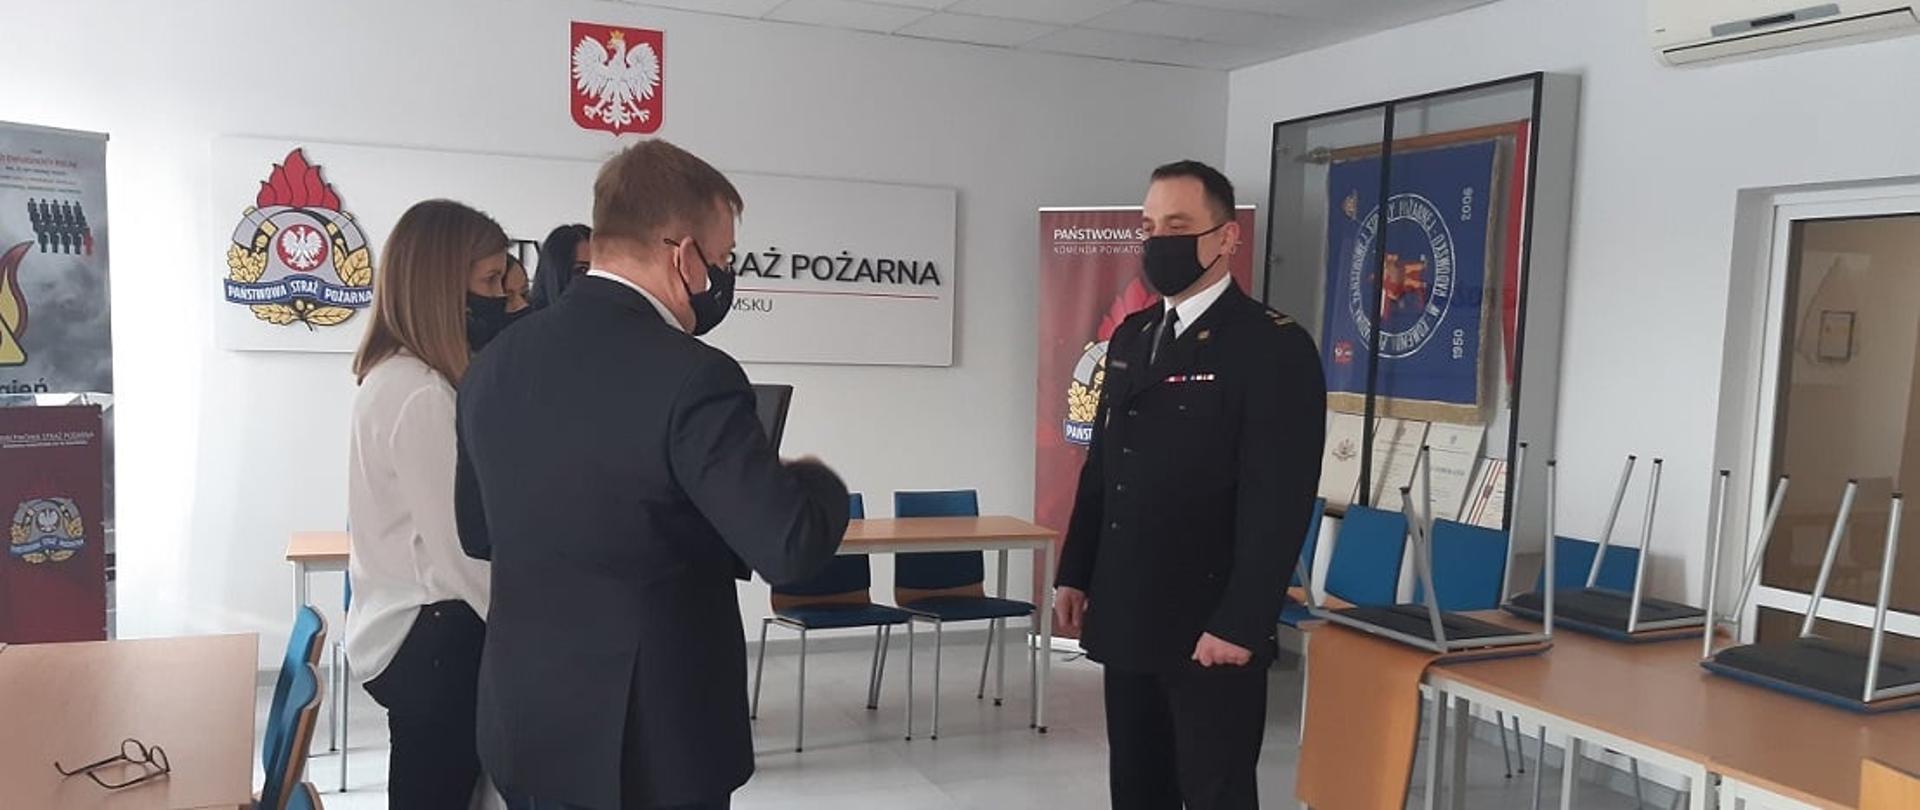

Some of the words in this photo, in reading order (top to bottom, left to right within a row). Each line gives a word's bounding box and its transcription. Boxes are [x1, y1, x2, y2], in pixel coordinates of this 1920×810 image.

[1053, 225, 1132, 240] PAŃSTWOWA
[1100, 245, 1144, 254] POWIATO
[728, 246, 781, 278] RAŻ
[791, 250, 940, 286] POŻARNA
[228, 285, 287, 300] PAŃSTWOWA
[290, 279, 319, 293] STRAŻ
[324, 288, 374, 304] POŻARNA
[732, 298, 773, 312] MSKU
